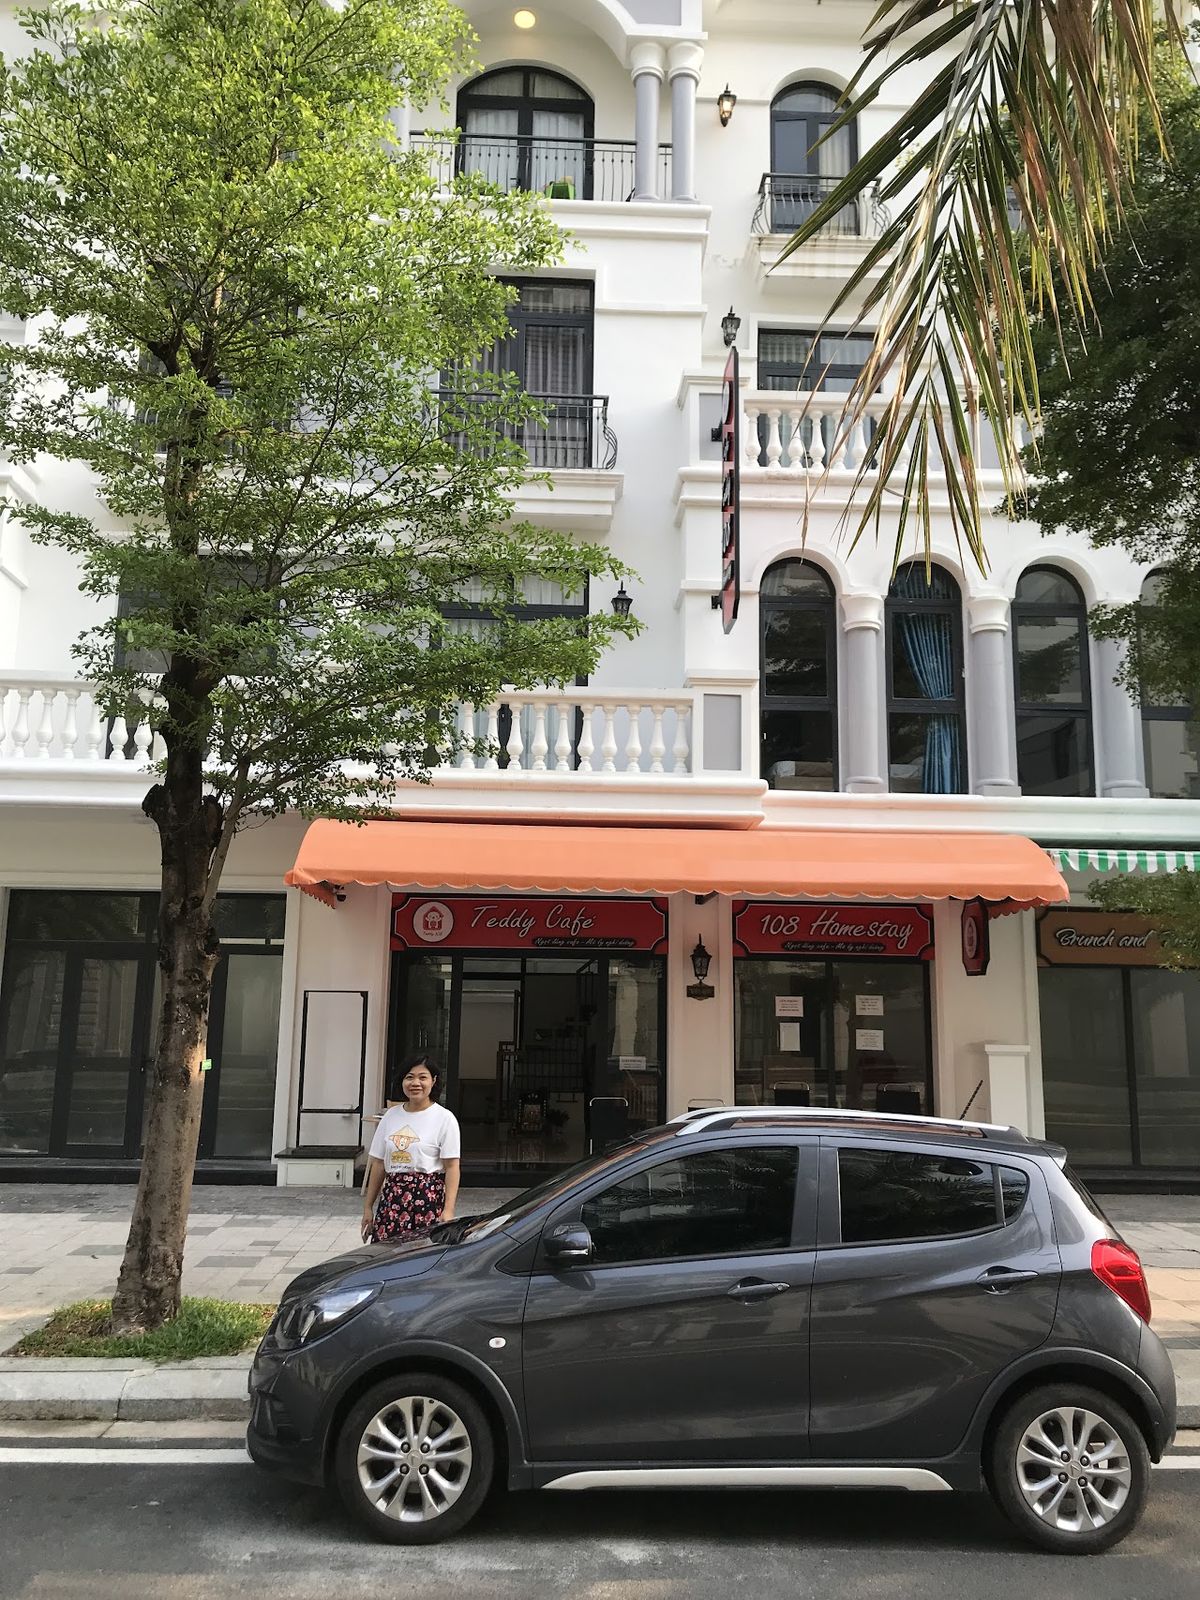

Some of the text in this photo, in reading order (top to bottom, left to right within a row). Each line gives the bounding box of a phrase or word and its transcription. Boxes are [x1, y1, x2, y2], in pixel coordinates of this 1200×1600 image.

[471, 904, 597, 938] Teddy Café
[761, 914, 800, 935] 108
[1055, 928, 1115, 947] Brunch
[1118, 929, 1157, 947] and
